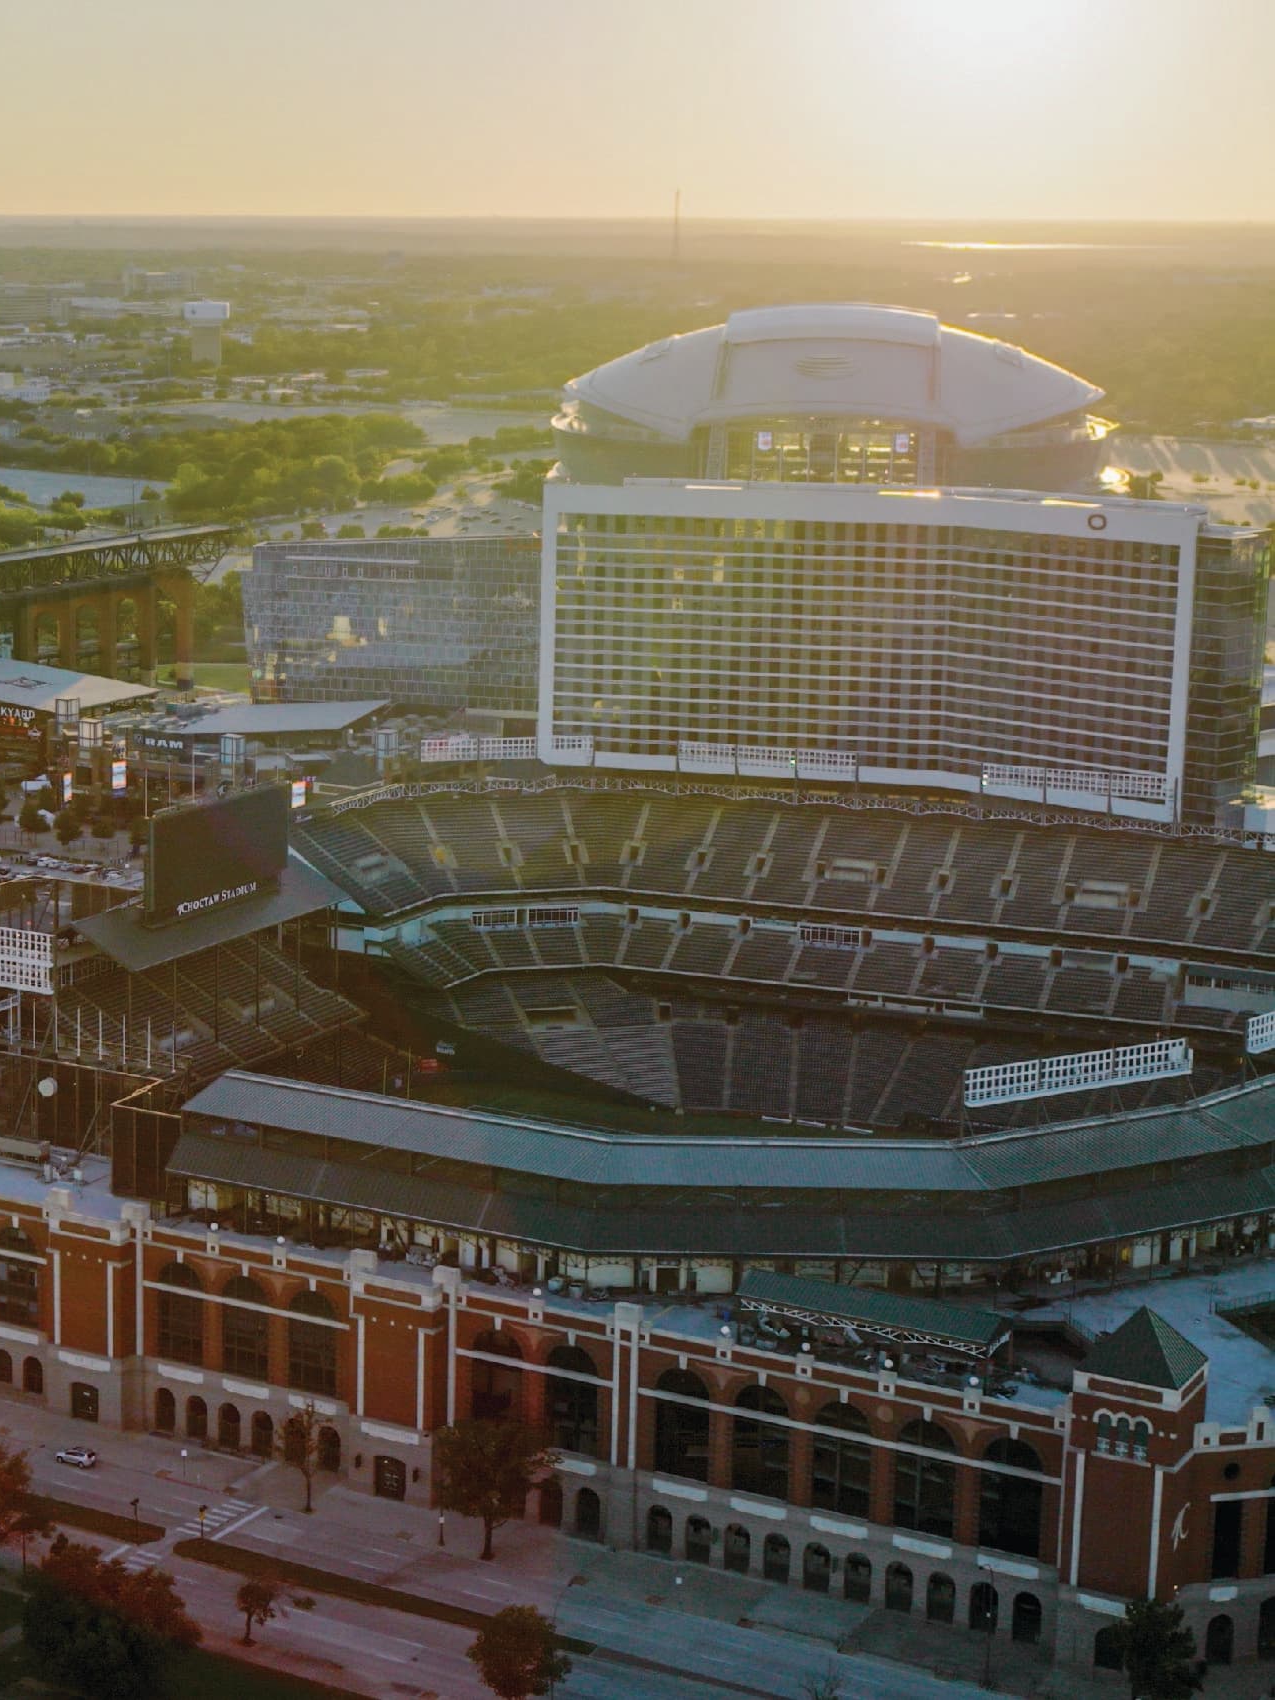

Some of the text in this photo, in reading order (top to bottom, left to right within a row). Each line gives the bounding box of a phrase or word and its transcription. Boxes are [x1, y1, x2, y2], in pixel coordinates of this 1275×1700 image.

[145, 737, 183, 749] RAM
[181, 881, 257, 913] CHOCTAW STADIUM
